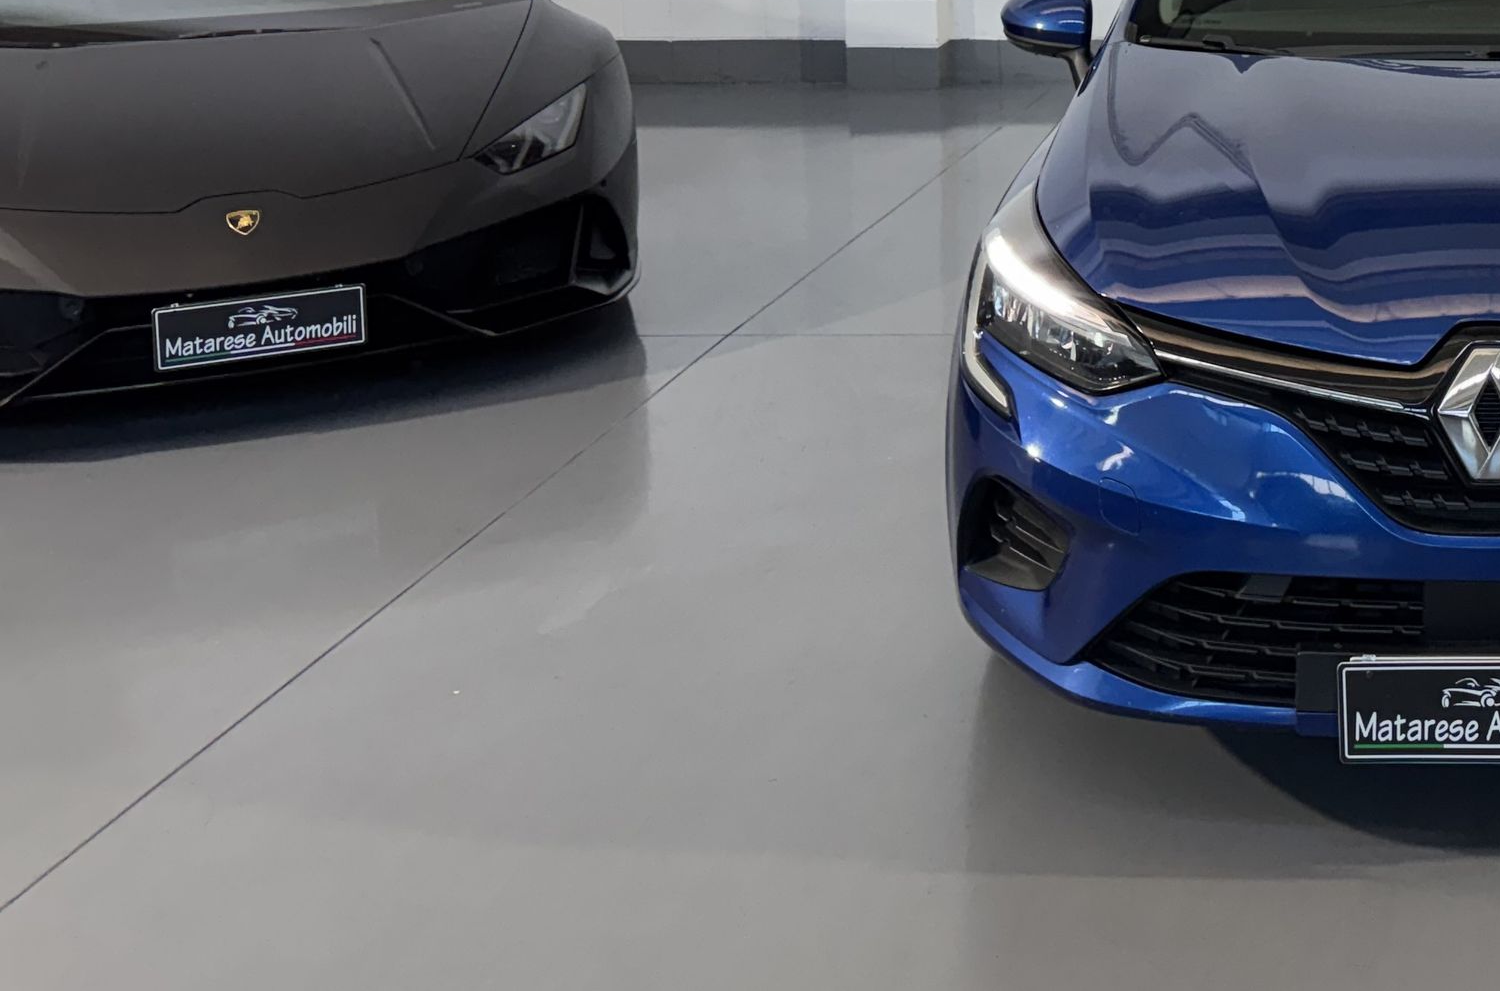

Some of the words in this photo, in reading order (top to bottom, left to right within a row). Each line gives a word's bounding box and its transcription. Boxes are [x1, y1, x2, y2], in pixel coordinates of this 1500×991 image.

[164, 333, 257, 359] Matarese
[261, 314, 357, 346] Automobili
[1355, 711, 1480, 742] Matarese
